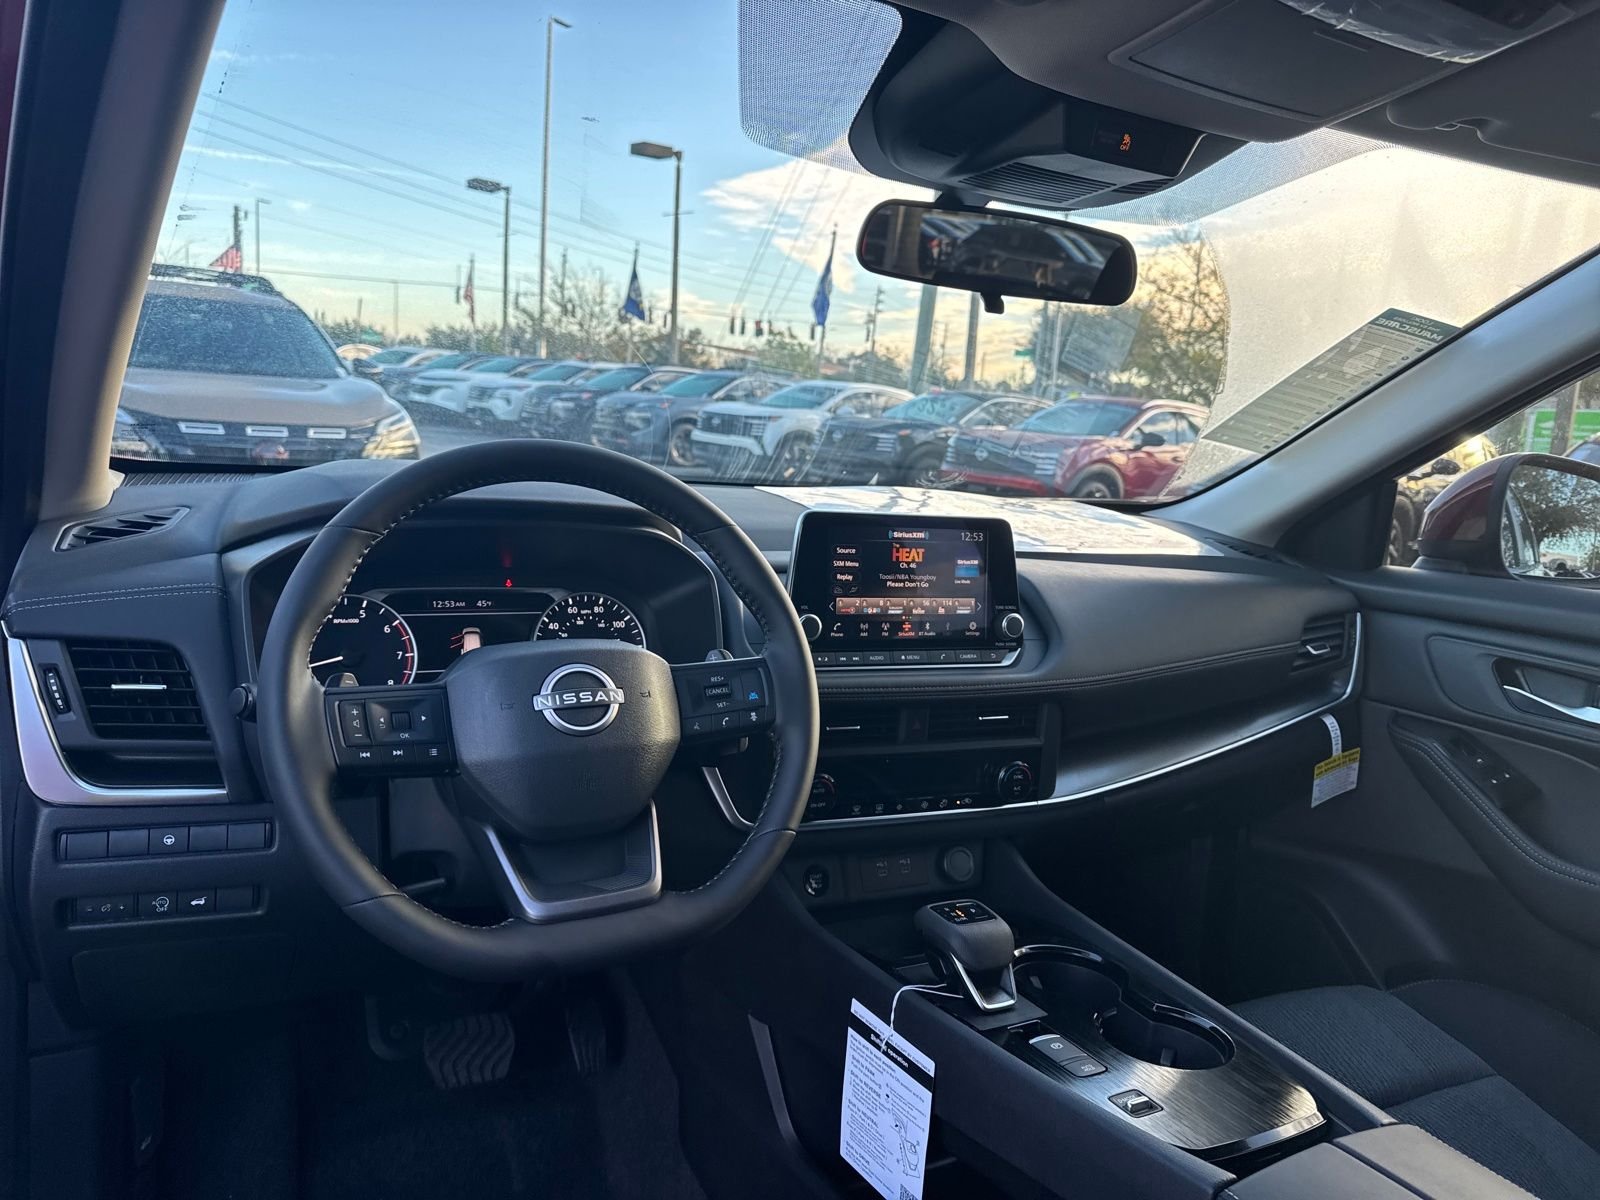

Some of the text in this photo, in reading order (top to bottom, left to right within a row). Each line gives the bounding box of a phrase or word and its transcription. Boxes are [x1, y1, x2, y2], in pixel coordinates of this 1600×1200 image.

[961, 532, 984, 542] 12:53
[892, 548, 925, 562] HEAT
[359, 610, 366, 618] 5
[384, 625, 391, 634] 6
[397, 651, 402, 660] 7
[537, 690, 623, 708] NISSAN
